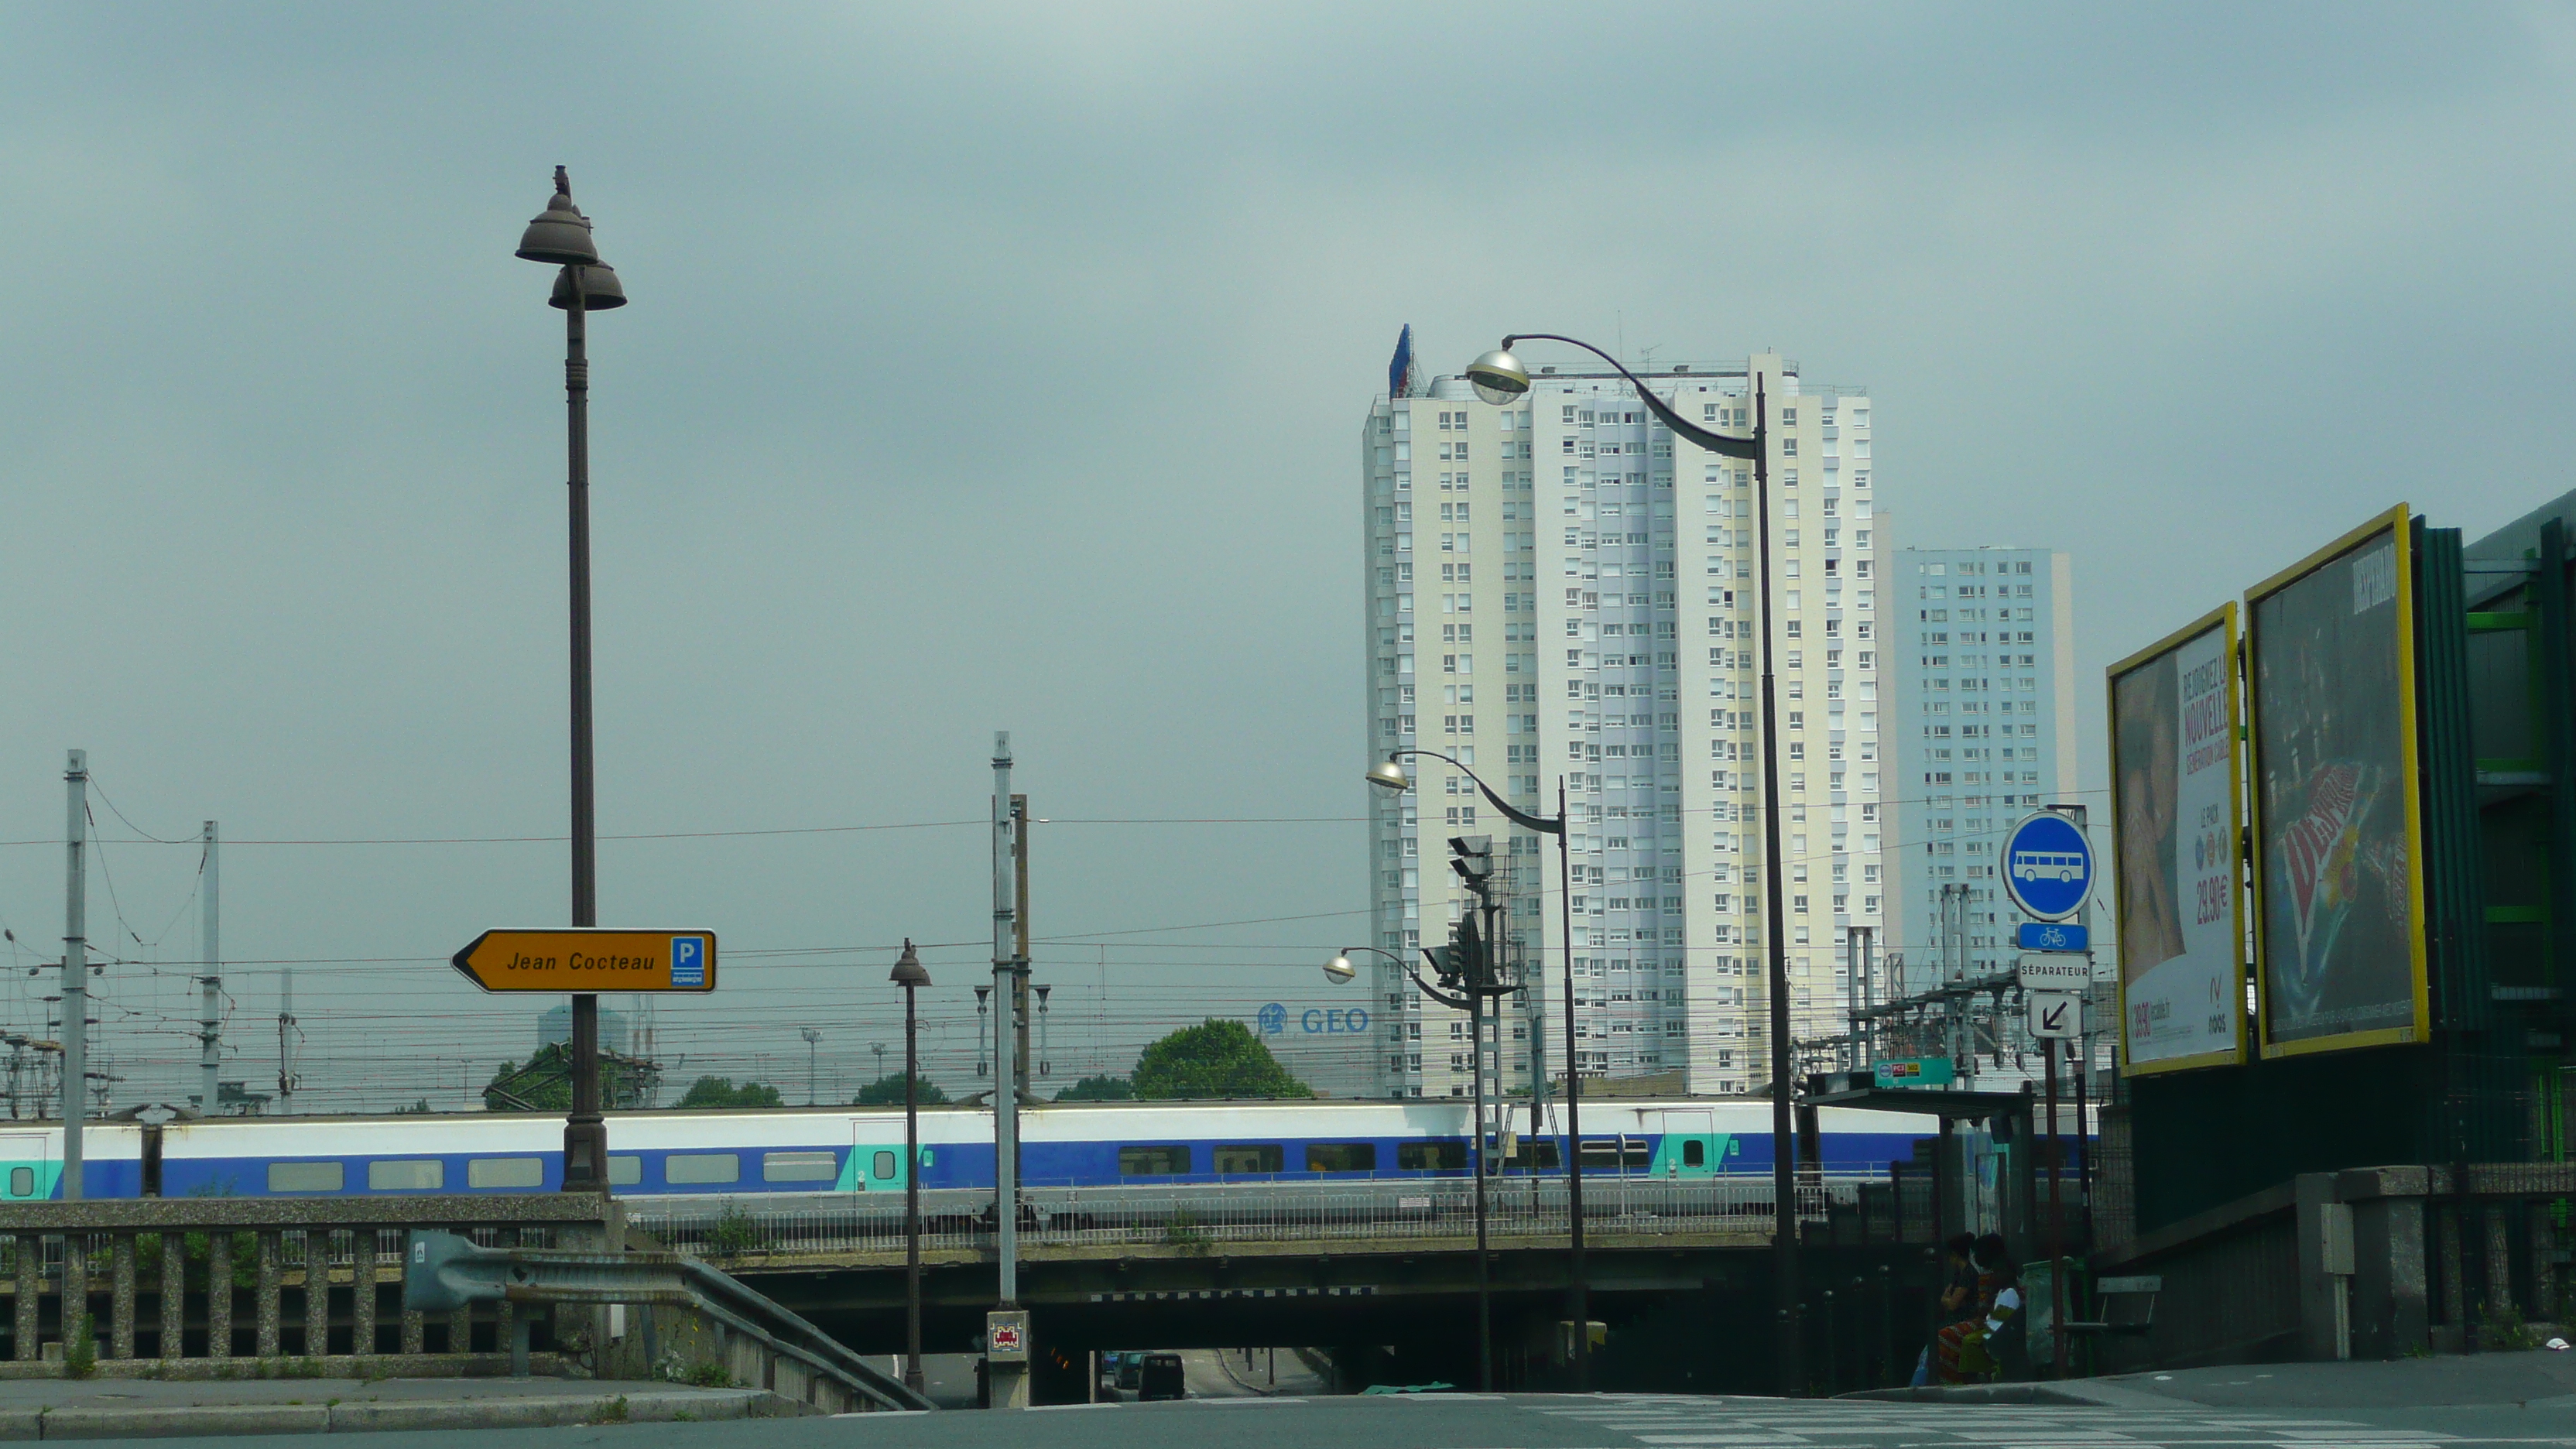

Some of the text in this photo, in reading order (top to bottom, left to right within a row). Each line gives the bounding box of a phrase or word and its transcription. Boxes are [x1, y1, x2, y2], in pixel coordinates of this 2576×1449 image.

[2184, 687, 2228, 748] NOUVELLE
[507, 952, 655, 971] Jean Cocteau
[680, 943, 695, 964] P
[2021, 963, 2088, 977] SÉPARATEUR
[1301, 1008, 1369, 1033] GEO
[858, 1170, 865, 1181] 2
